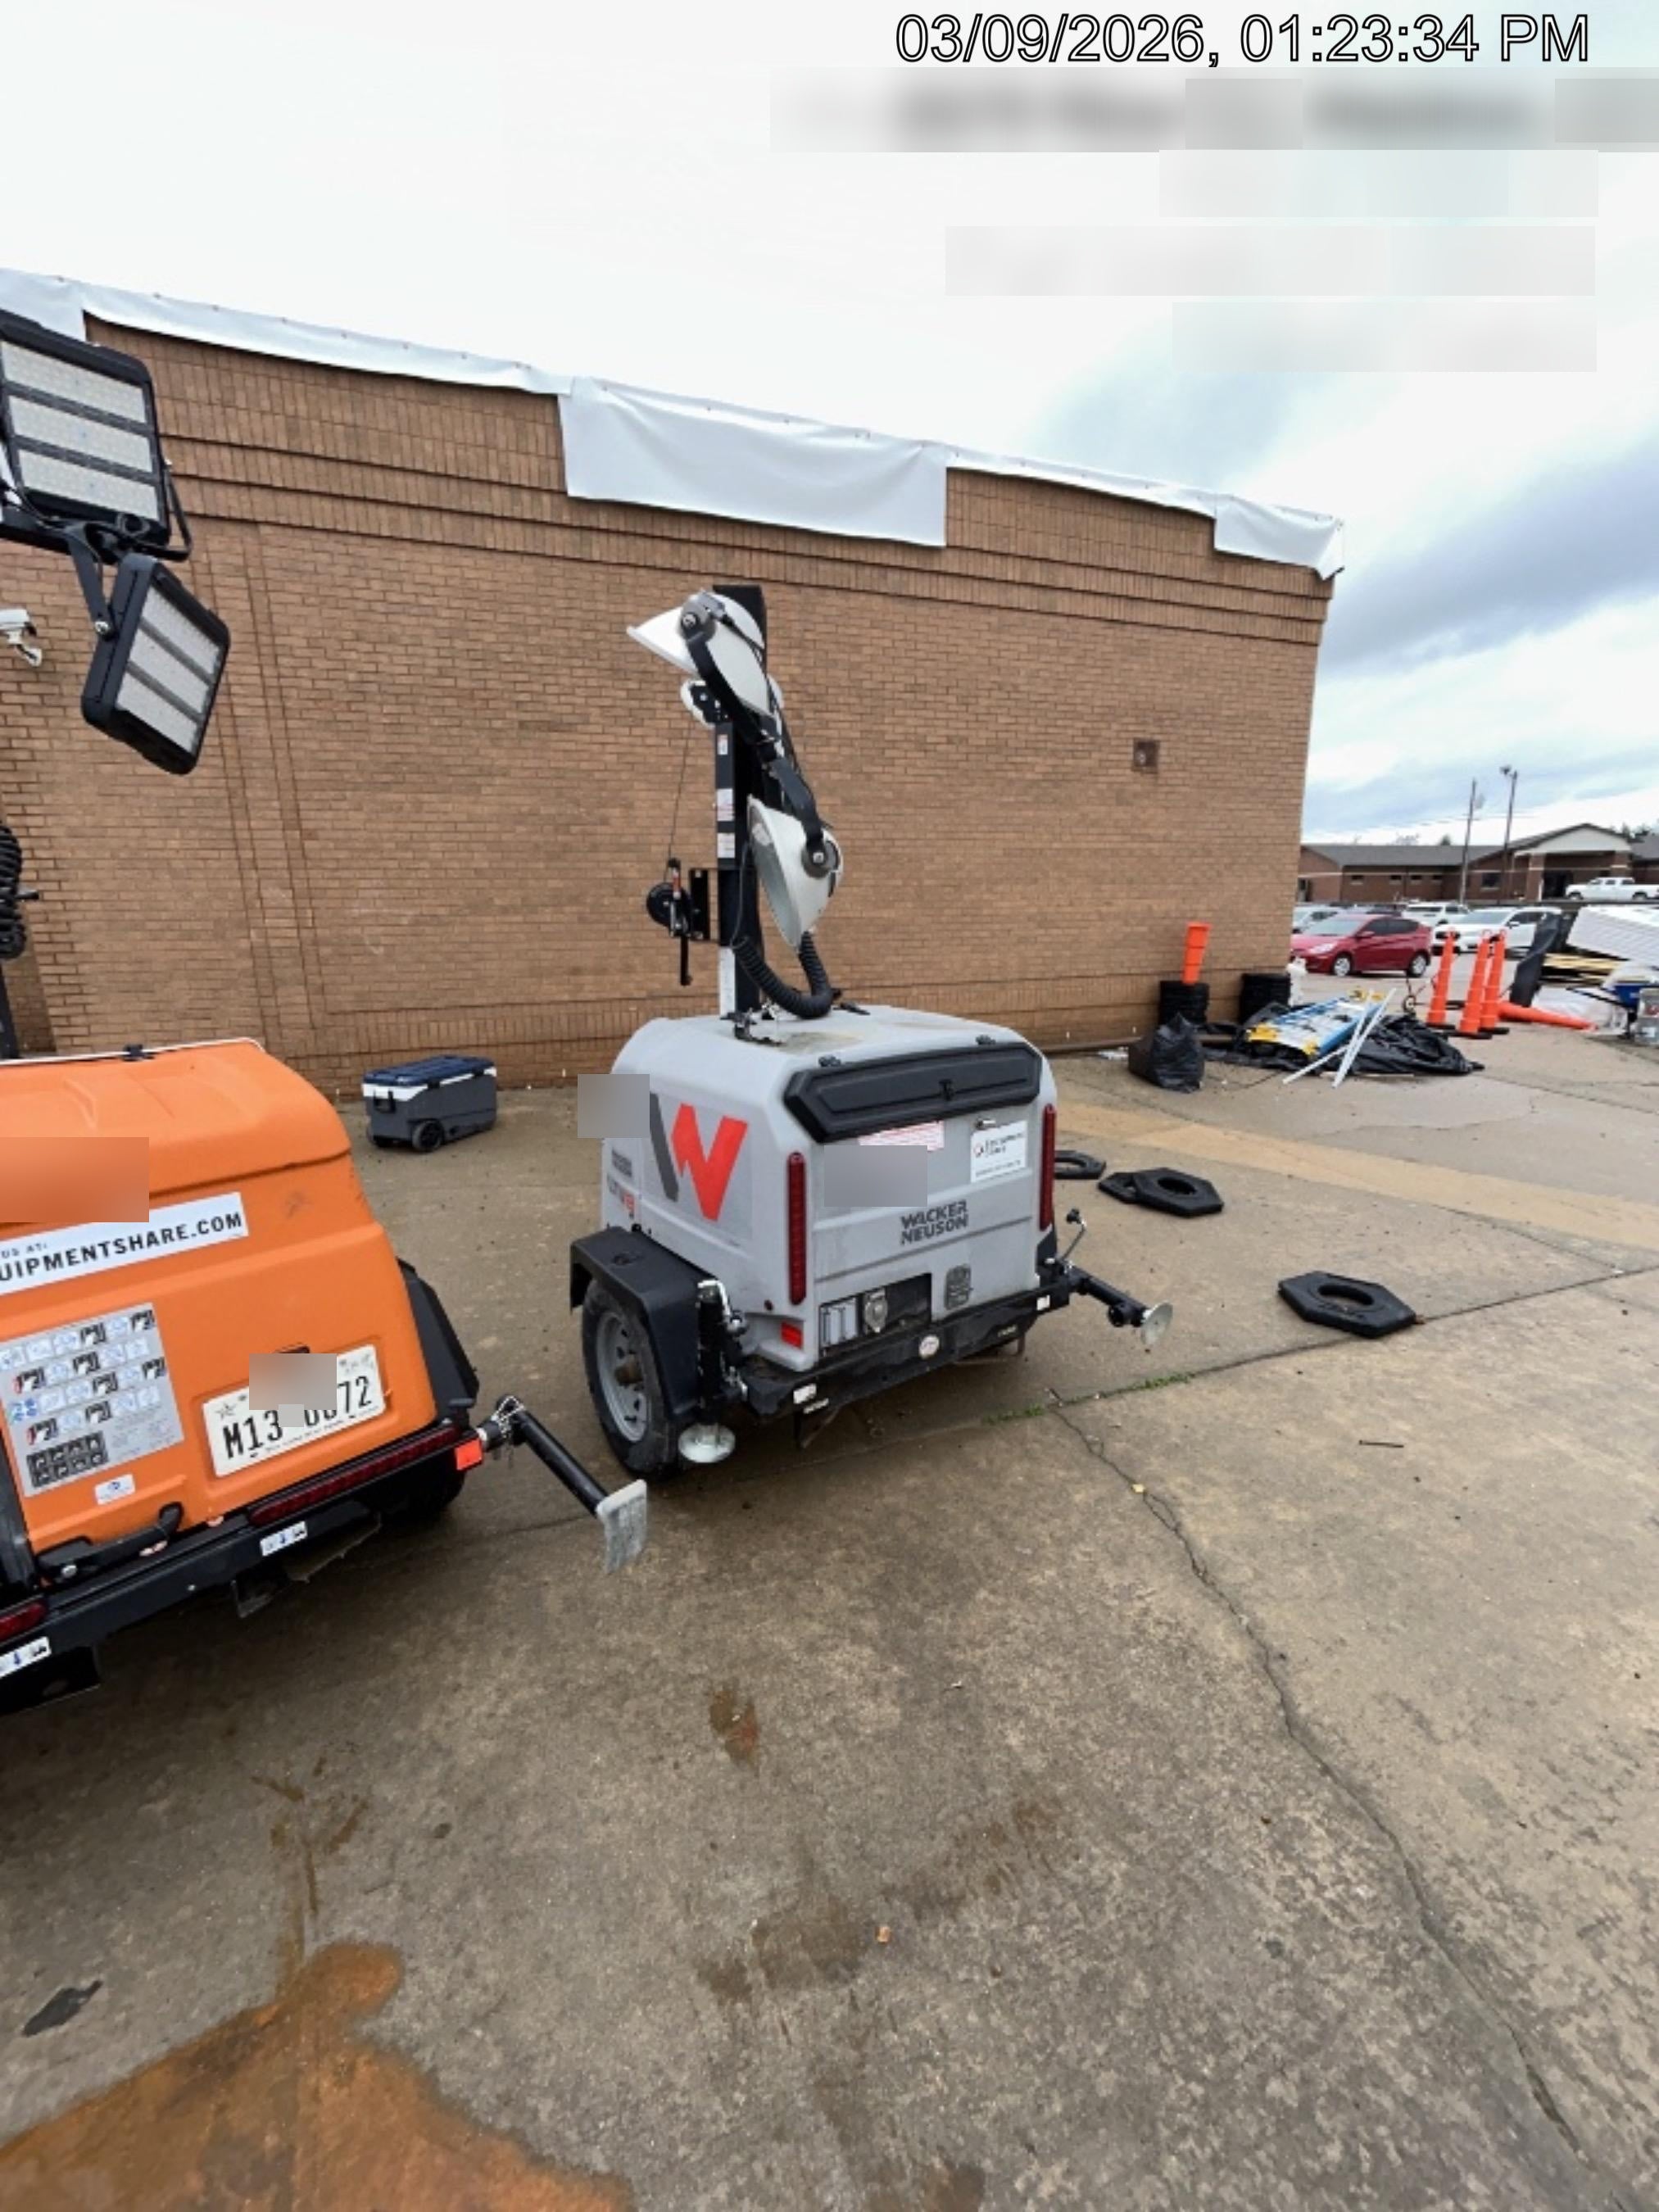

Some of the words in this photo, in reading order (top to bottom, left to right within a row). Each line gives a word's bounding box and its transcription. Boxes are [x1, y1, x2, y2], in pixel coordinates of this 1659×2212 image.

[900, 1199, 968, 1229] WACKER
[900, 1213, 969, 1245] NEUSON
[0, 1211, 243, 1282] UIPMENTSHARE.COM
